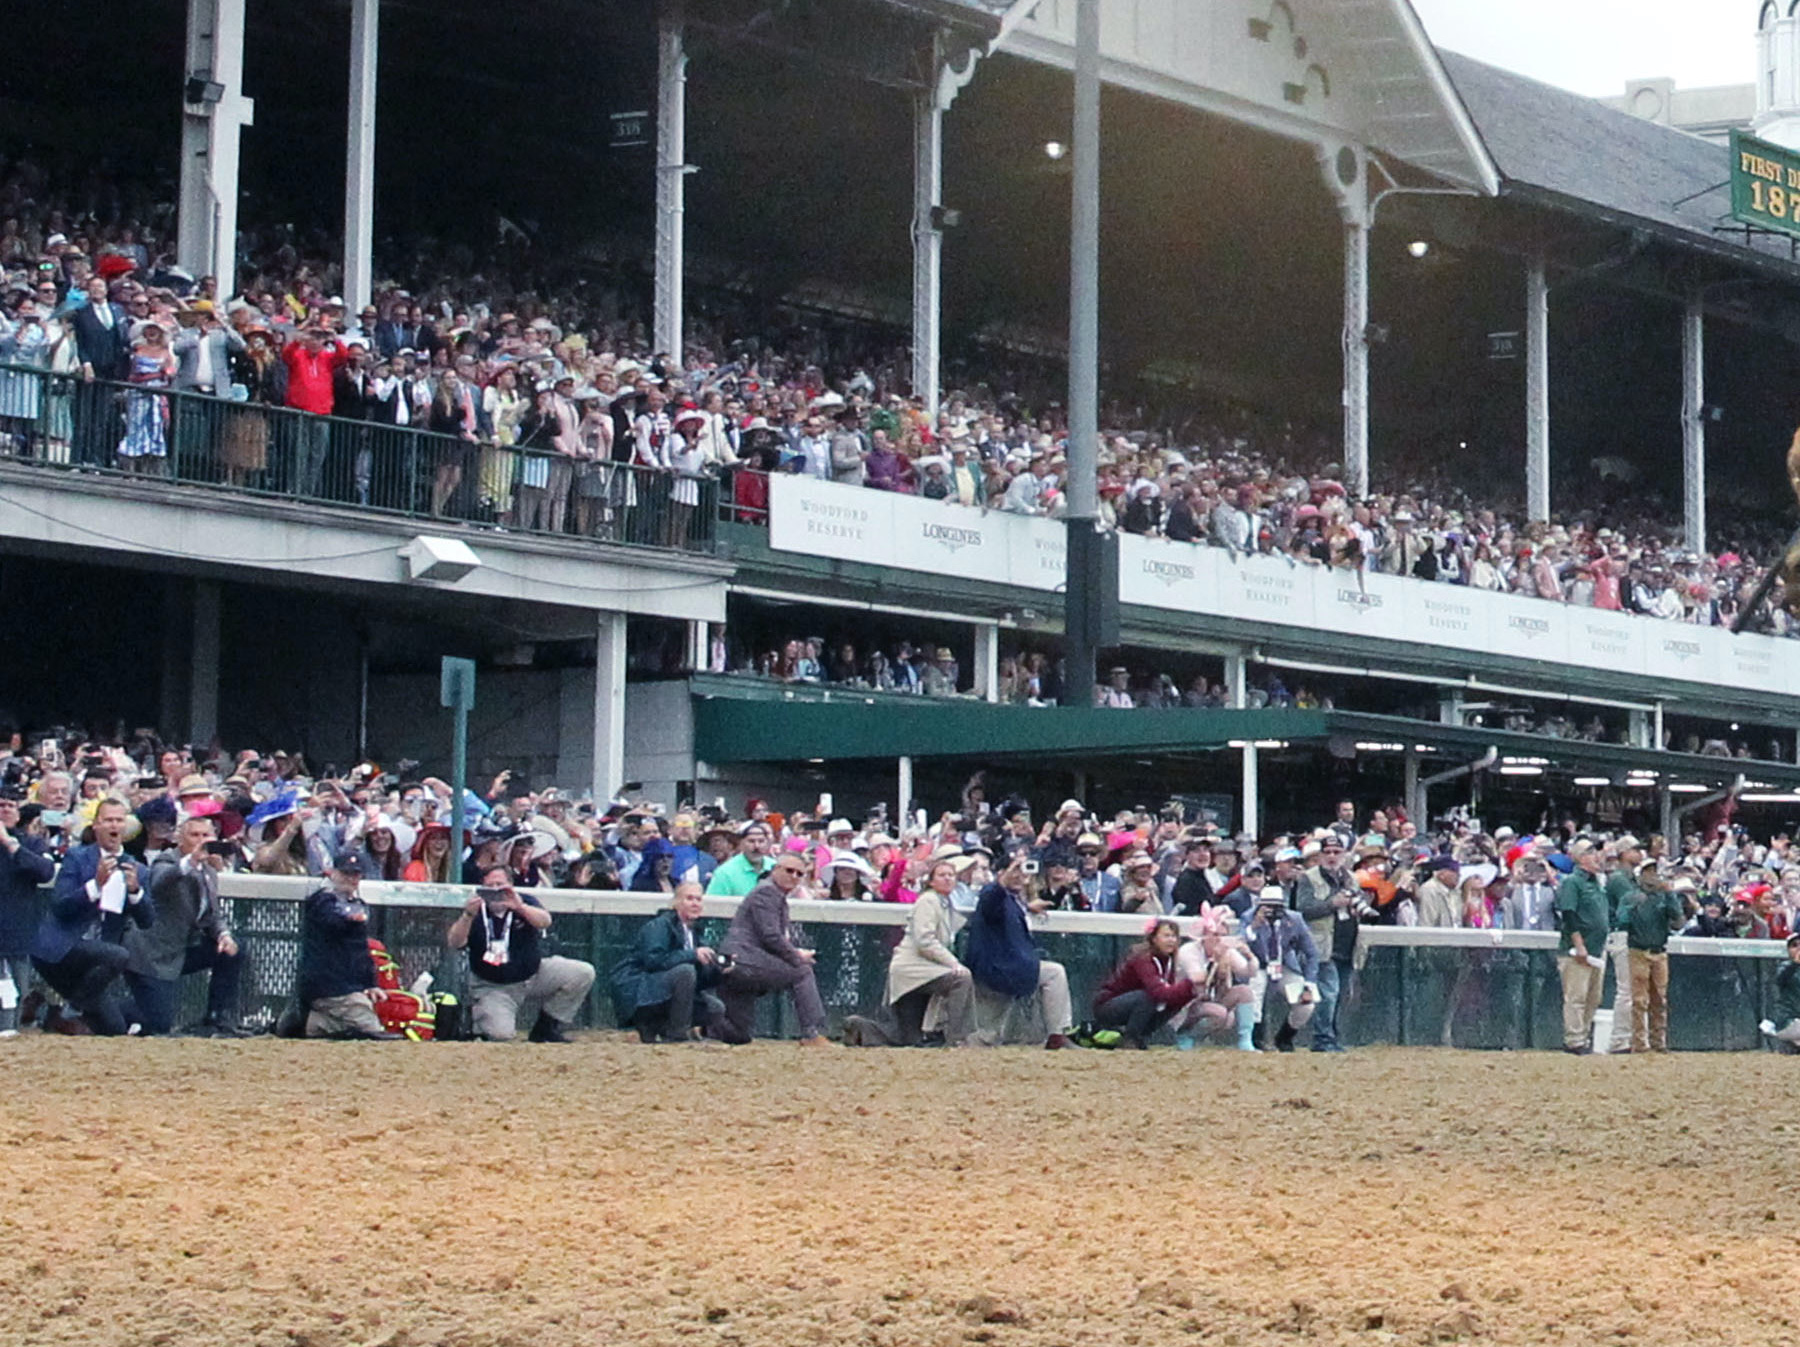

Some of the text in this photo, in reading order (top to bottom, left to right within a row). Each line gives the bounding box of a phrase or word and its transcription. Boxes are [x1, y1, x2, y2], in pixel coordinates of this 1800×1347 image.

[1741, 152, 1782, 182] FIRST
[800, 499, 869, 522] WOODFORD
[807, 519, 863, 540] RESERVE
[922, 523, 982, 546] LONGINES
[1143, 559, 1195, 579] LONGINES
